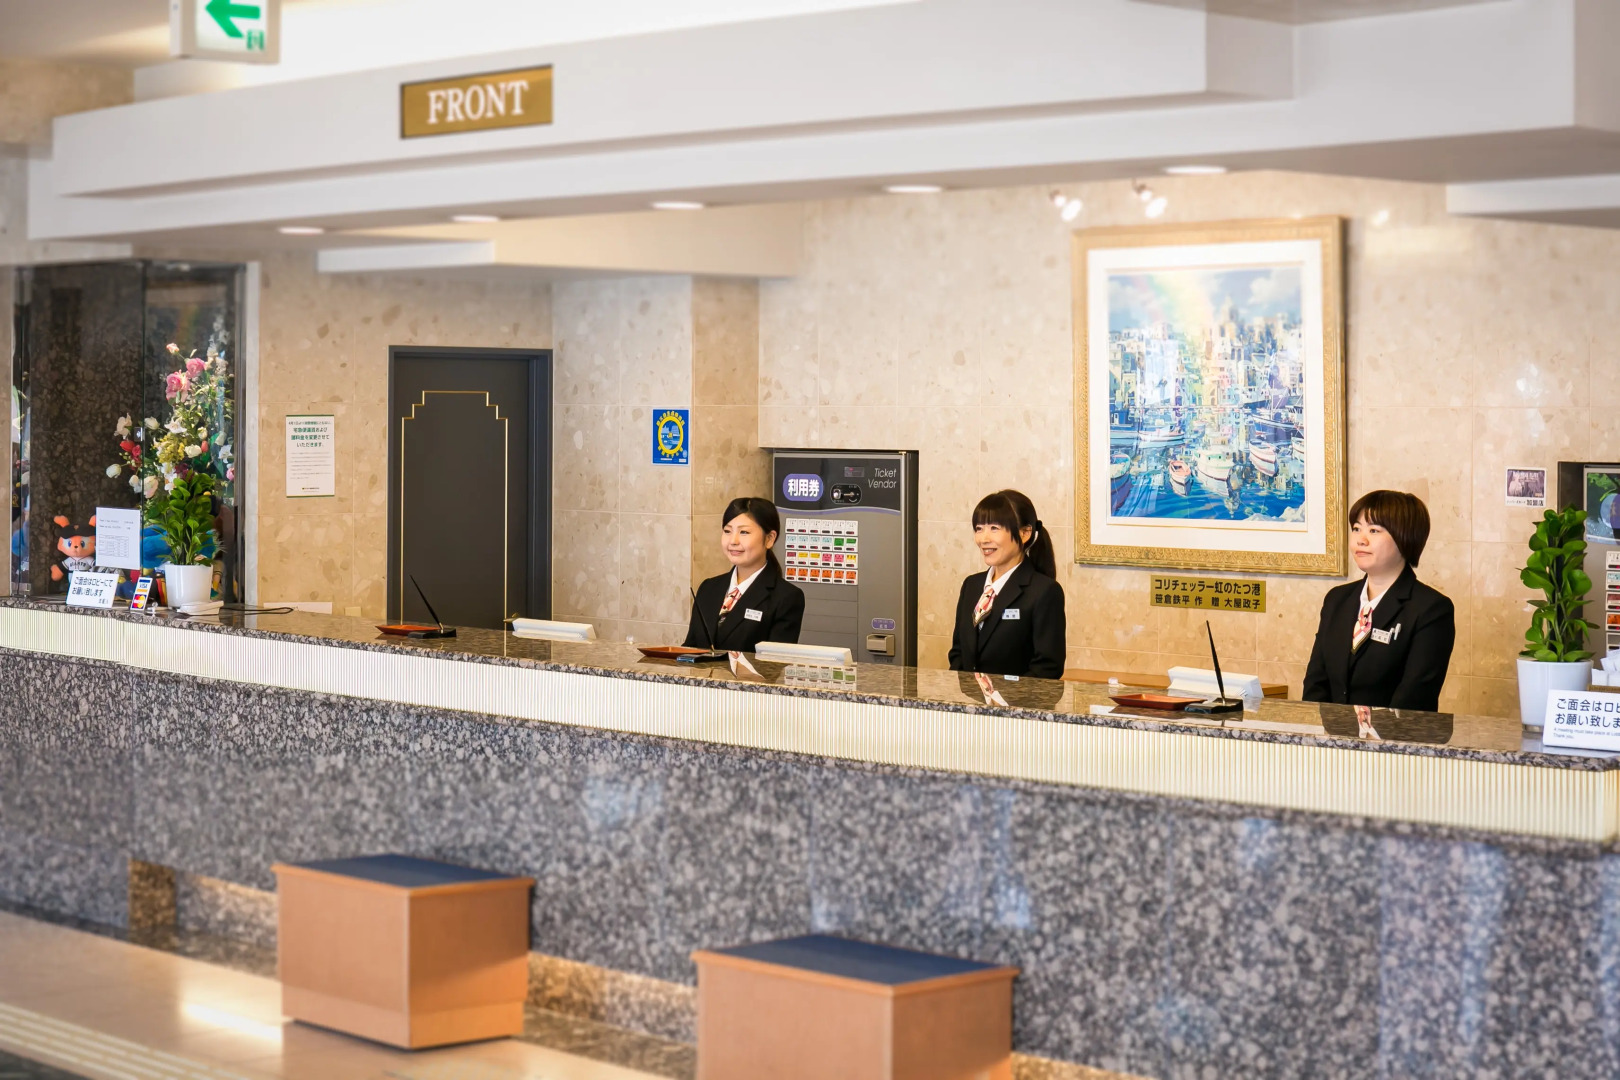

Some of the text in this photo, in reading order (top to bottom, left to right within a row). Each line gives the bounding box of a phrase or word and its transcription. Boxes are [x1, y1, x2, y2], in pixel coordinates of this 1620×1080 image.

[427, 80, 529, 124] FRONT
[874, 467, 897, 478] Ticket
[788, 479, 819, 497] 利用券
[868, 478, 897, 489] Vendor
[74, 576, 114, 588] ご面会はロビーにて
[71, 587, 104, 598] お願い致します
[1155, 594, 1190, 605] 笹倉鉄平
[1194, 596, 1203, 605] 作
[1224, 597, 1261, 610] 大屋政子
[1555, 713, 1620, 728] お願い致しま
